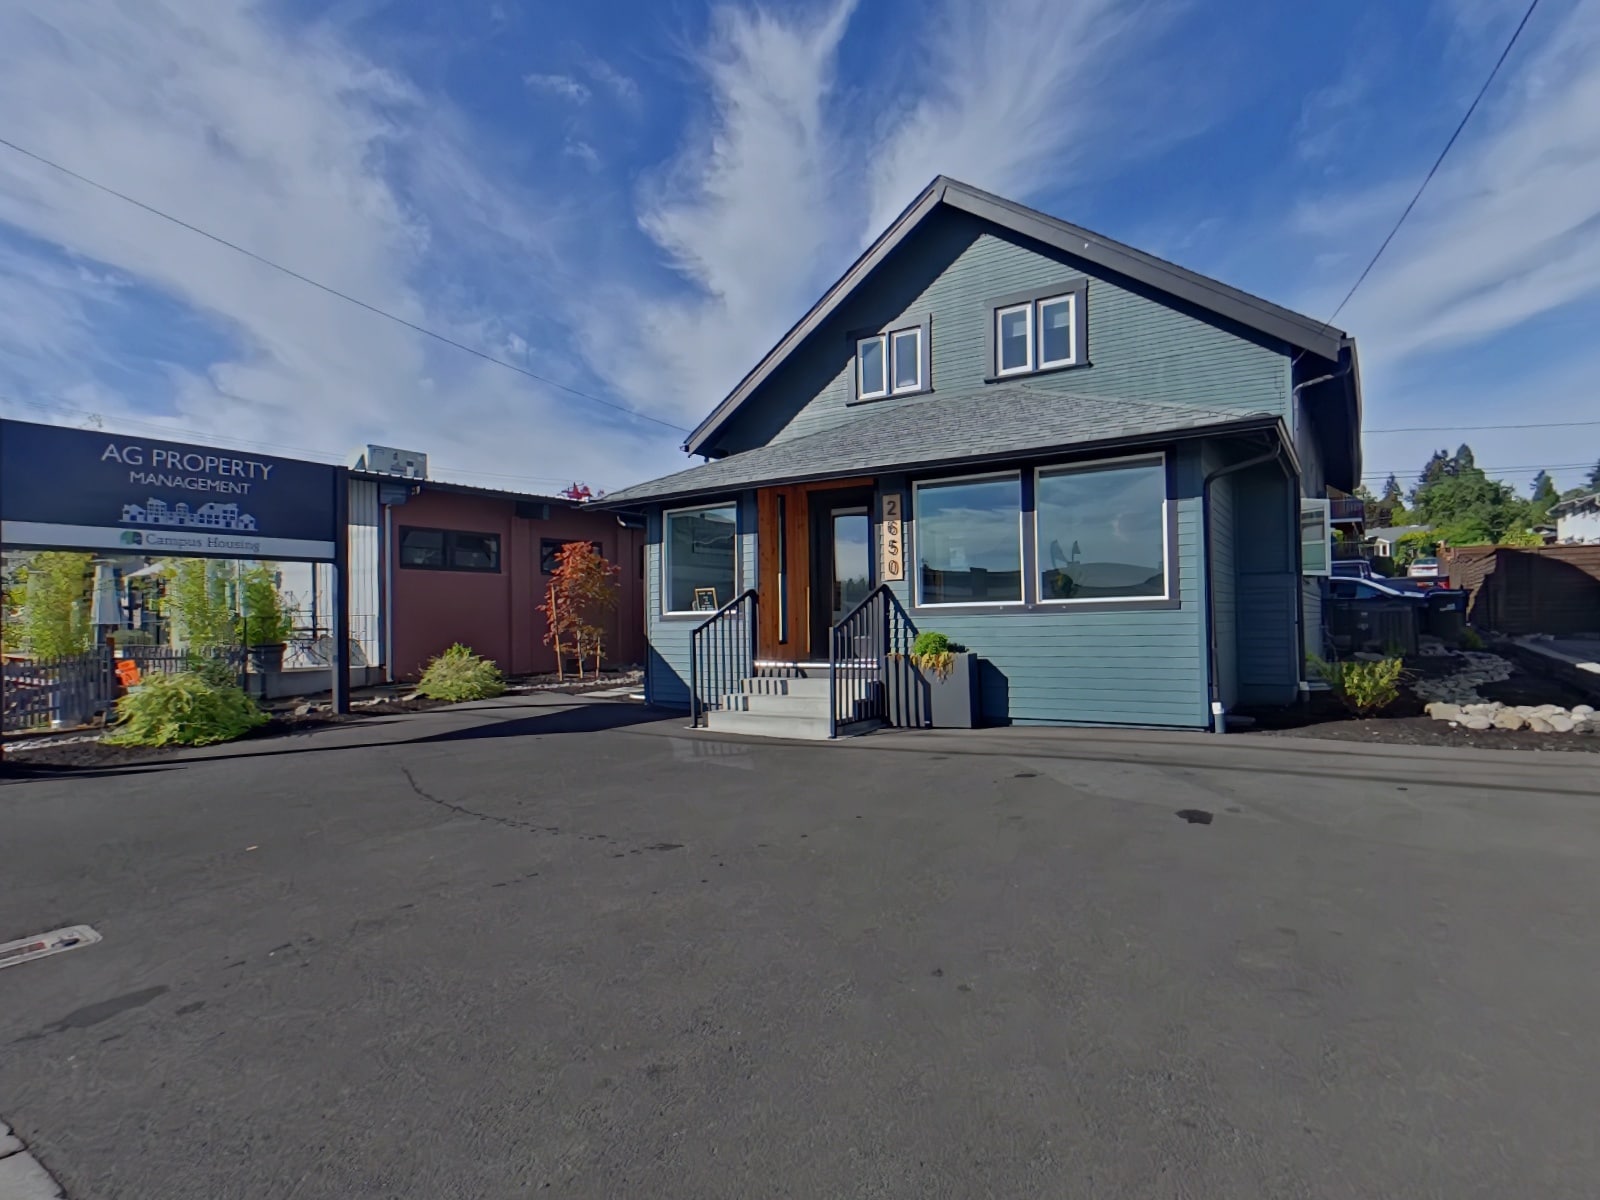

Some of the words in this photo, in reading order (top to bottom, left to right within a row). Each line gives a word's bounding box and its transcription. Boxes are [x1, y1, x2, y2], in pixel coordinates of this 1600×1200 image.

[101, 444, 143, 465] AG
[152, 449, 273, 480] PROPERTY
[129, 471, 251, 495] MANAGEMENT
[145, 533, 202, 550] Campus
[207, 536, 261, 552] Housing
[887, 500, 899, 576] 2650
